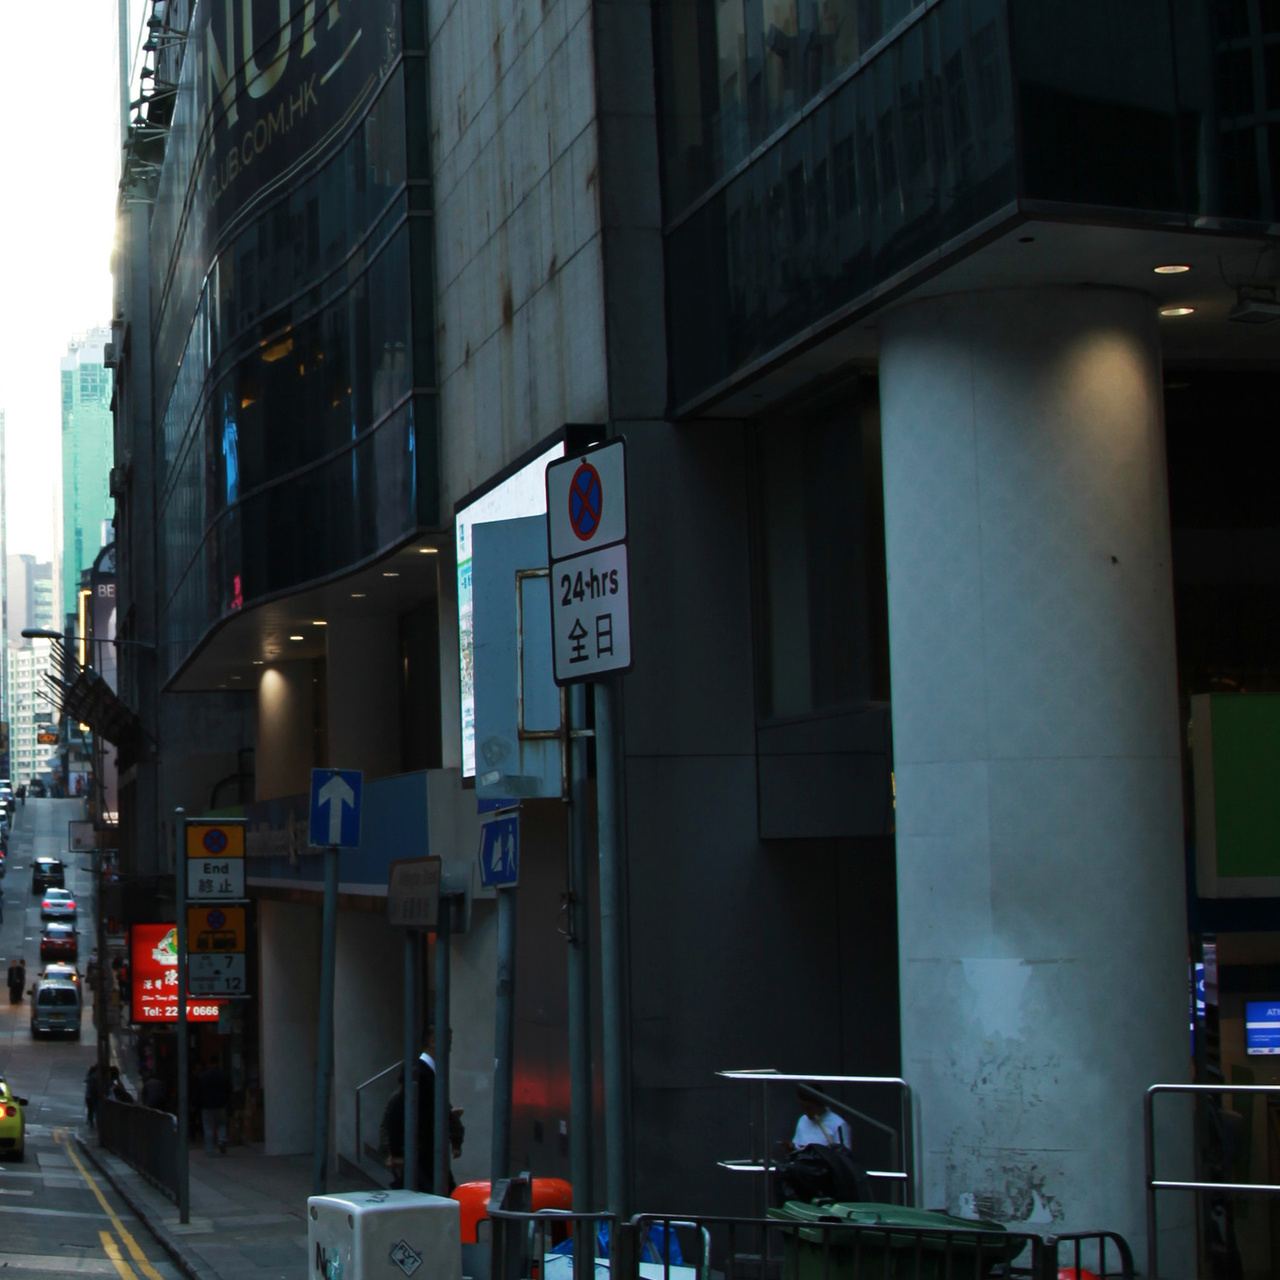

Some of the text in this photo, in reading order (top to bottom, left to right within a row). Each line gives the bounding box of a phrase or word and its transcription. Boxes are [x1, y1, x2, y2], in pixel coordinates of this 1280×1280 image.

[567, 612, 614, 664] 全日
[203, 862, 230, 874] End
[198, 878, 234, 894] 終止
[224, 955, 234, 969] 7
[225, 977, 242, 990] 12
[143, 1006, 162, 1017] Tel:
[193, 1006, 219, 1016] 0666
